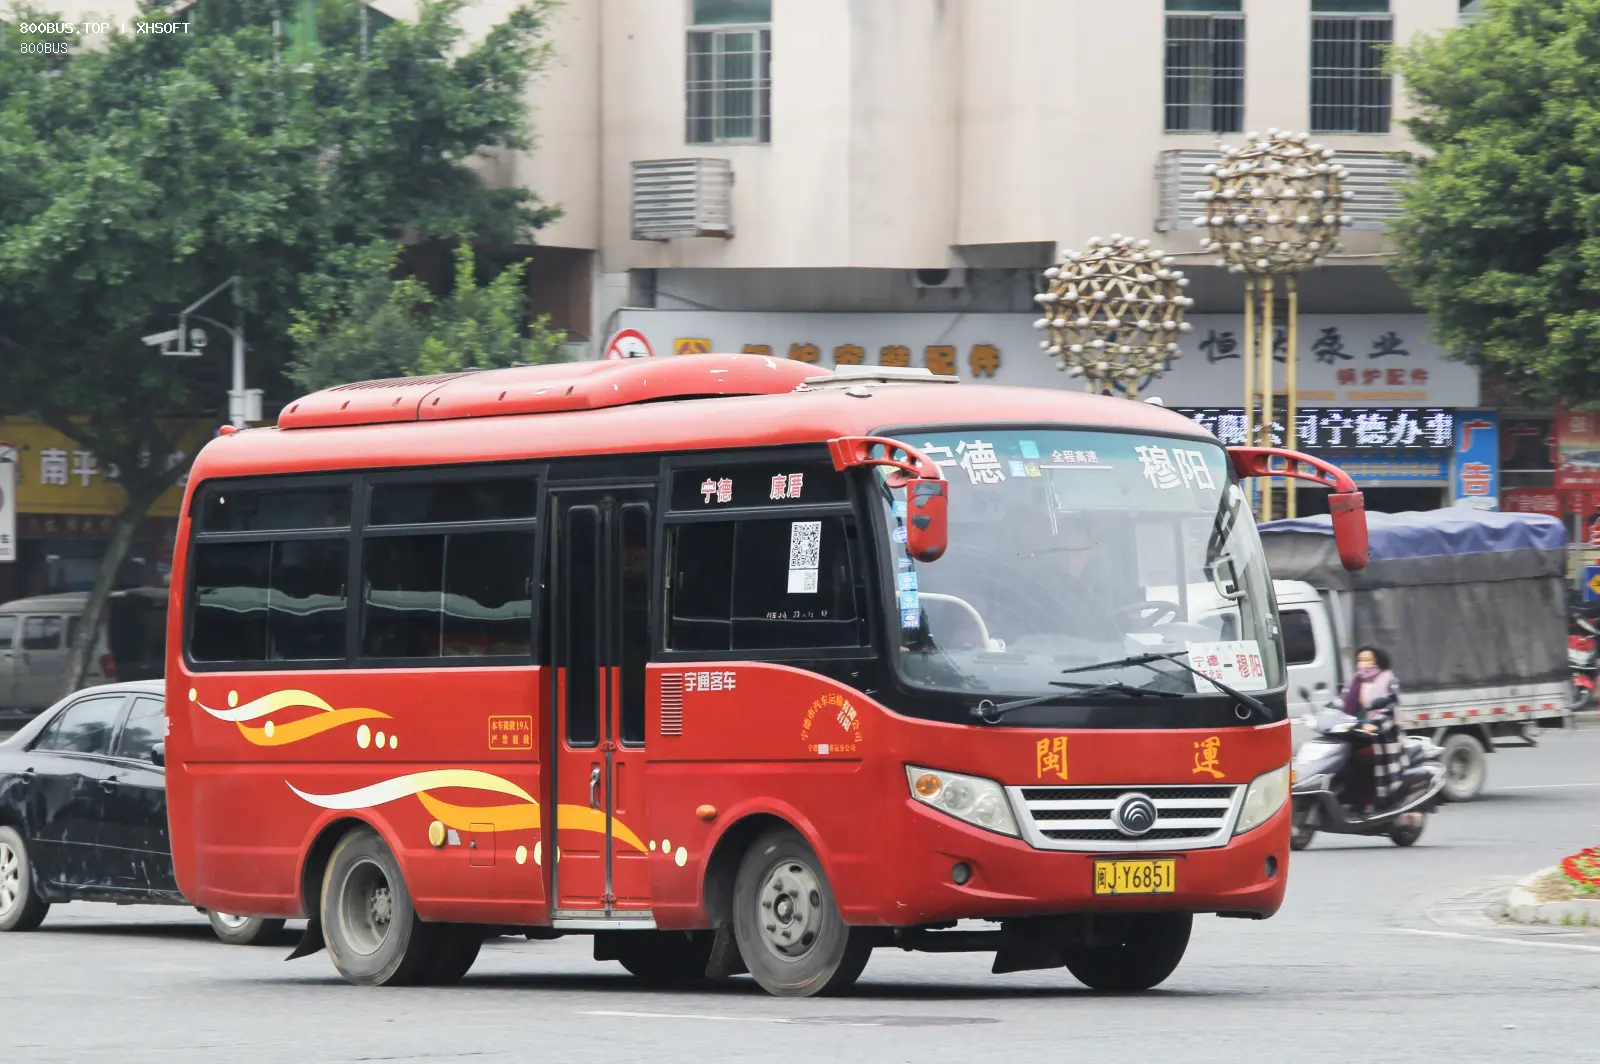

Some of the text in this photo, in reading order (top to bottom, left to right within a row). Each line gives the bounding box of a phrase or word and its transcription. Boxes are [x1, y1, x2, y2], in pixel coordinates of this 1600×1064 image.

[1052, 449, 1099, 464] 全程高速
[1134, 445, 1216, 490] 穆阳
[1460, 419, 1493, 495] 广告
[701, 473, 804, 504] 宁德 康厝
[684, 671, 737, 691] 宇通客车
[1192, 654, 1220, 668] 宁德
[1236, 653, 1263, 679] 穆阳
[1192, 736, 1226, 779] 運
